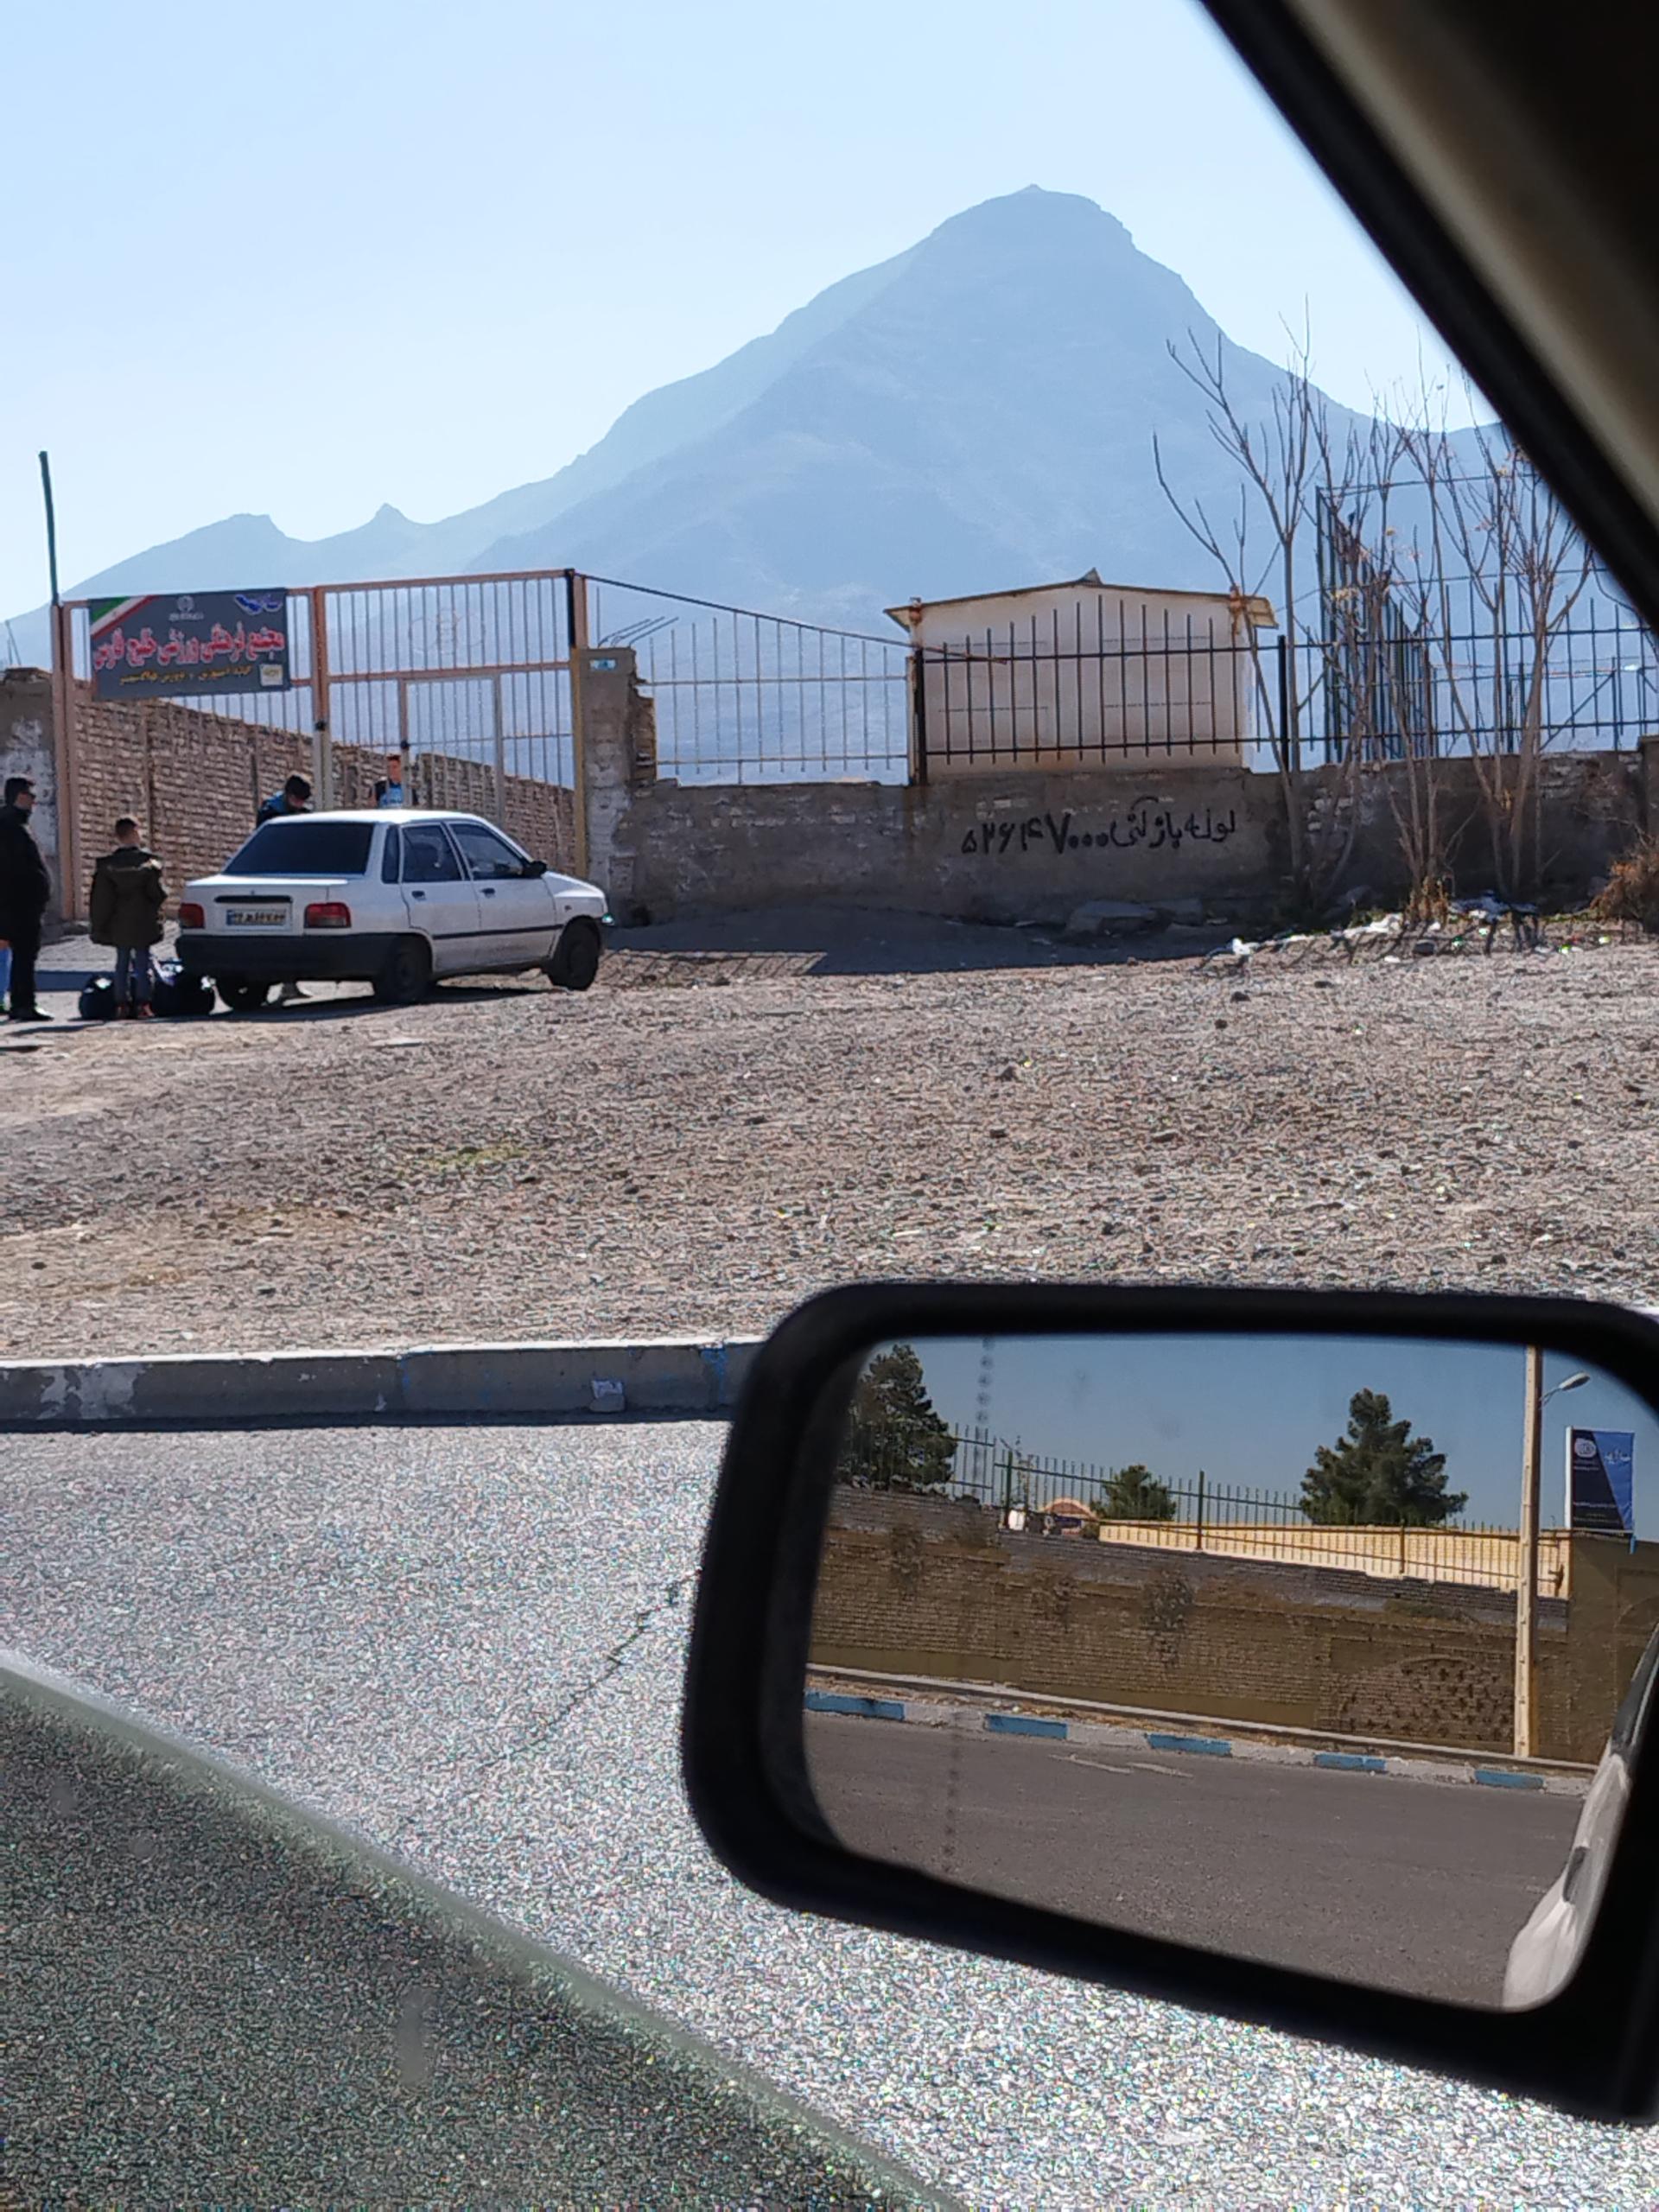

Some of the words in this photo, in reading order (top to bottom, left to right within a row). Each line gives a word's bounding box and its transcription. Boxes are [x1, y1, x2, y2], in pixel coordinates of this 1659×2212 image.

[94, 626, 125, 671] فارس
[127, 626, 157, 667] خلیج
[157, 627, 200, 667] ورزشی
[200, 620, 245, 664] فرهنگی
[245, 625, 285, 662] مجتمع
[1184, 808, 1236, 843] لوله
